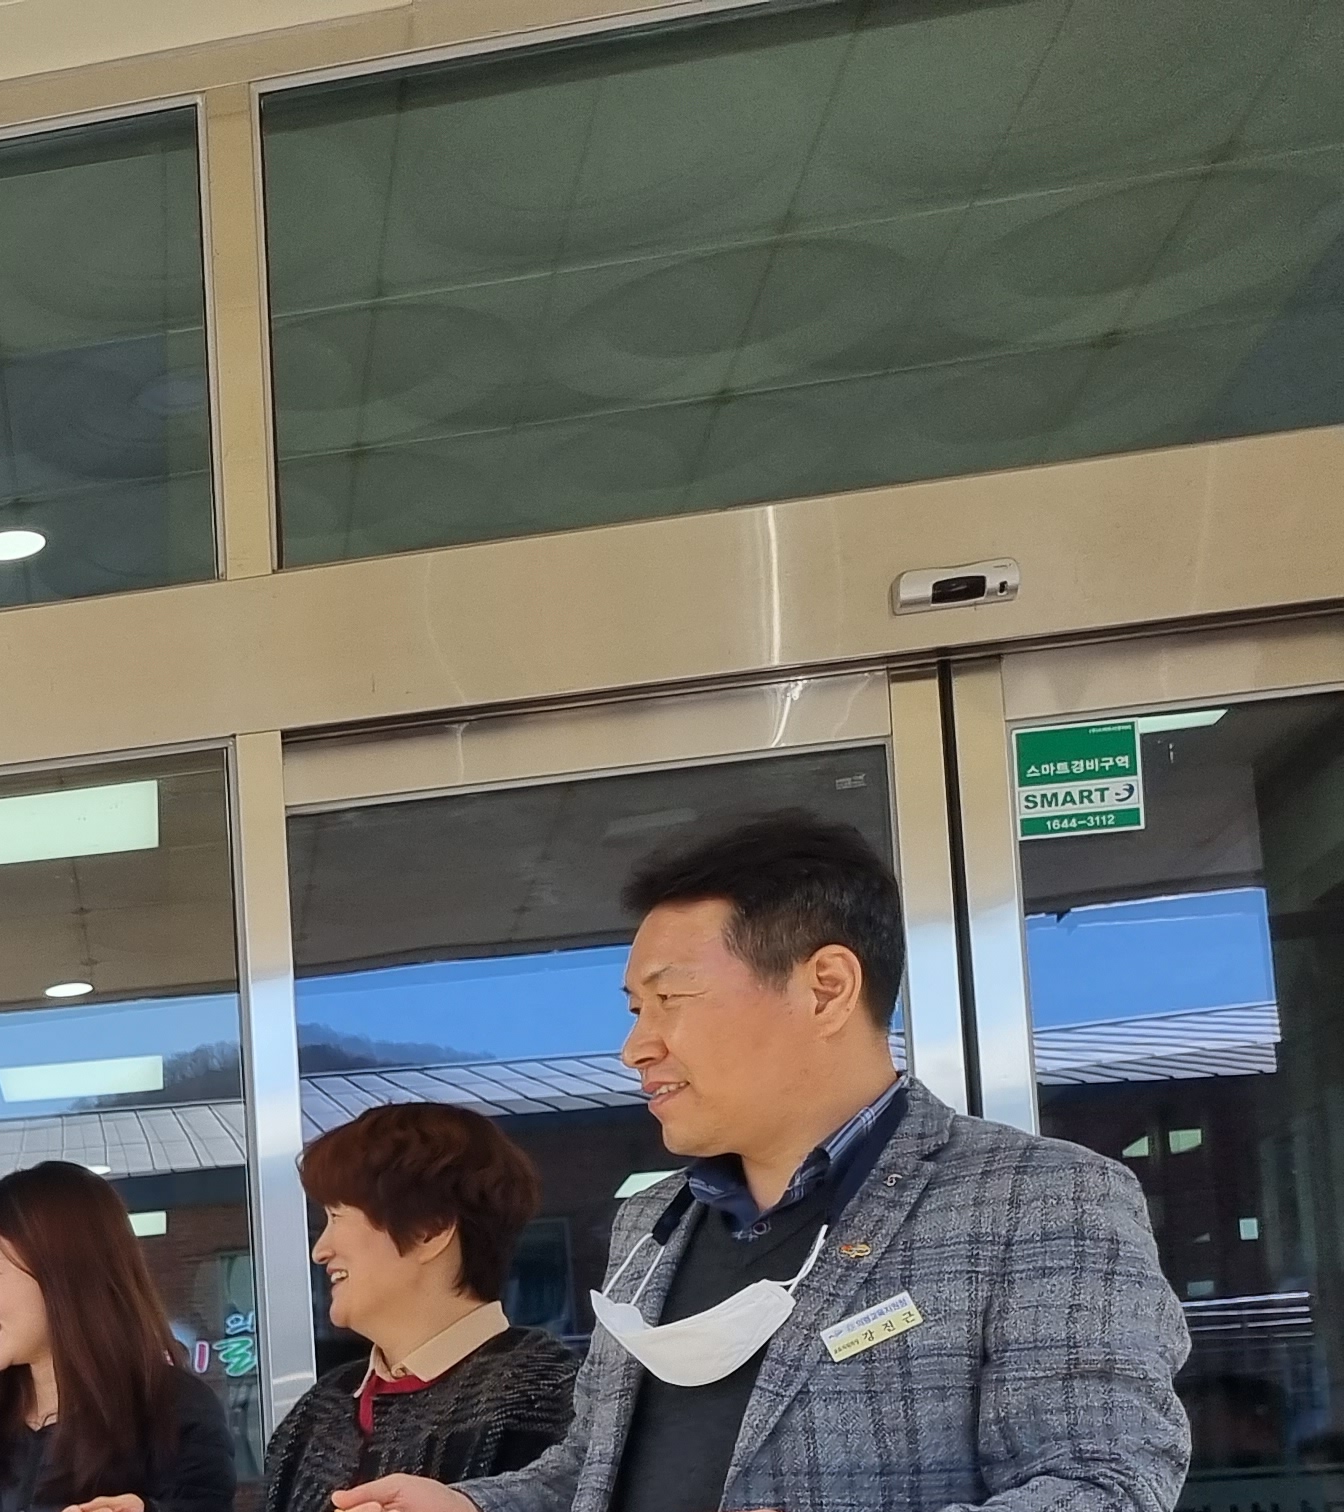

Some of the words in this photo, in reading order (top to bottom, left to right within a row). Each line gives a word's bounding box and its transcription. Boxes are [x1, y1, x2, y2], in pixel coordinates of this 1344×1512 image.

[1026, 755, 1130, 777] 스마트경비구역
[1024, 787, 1109, 810] SMART
[1046, 814, 1115, 831] 1644-3112
